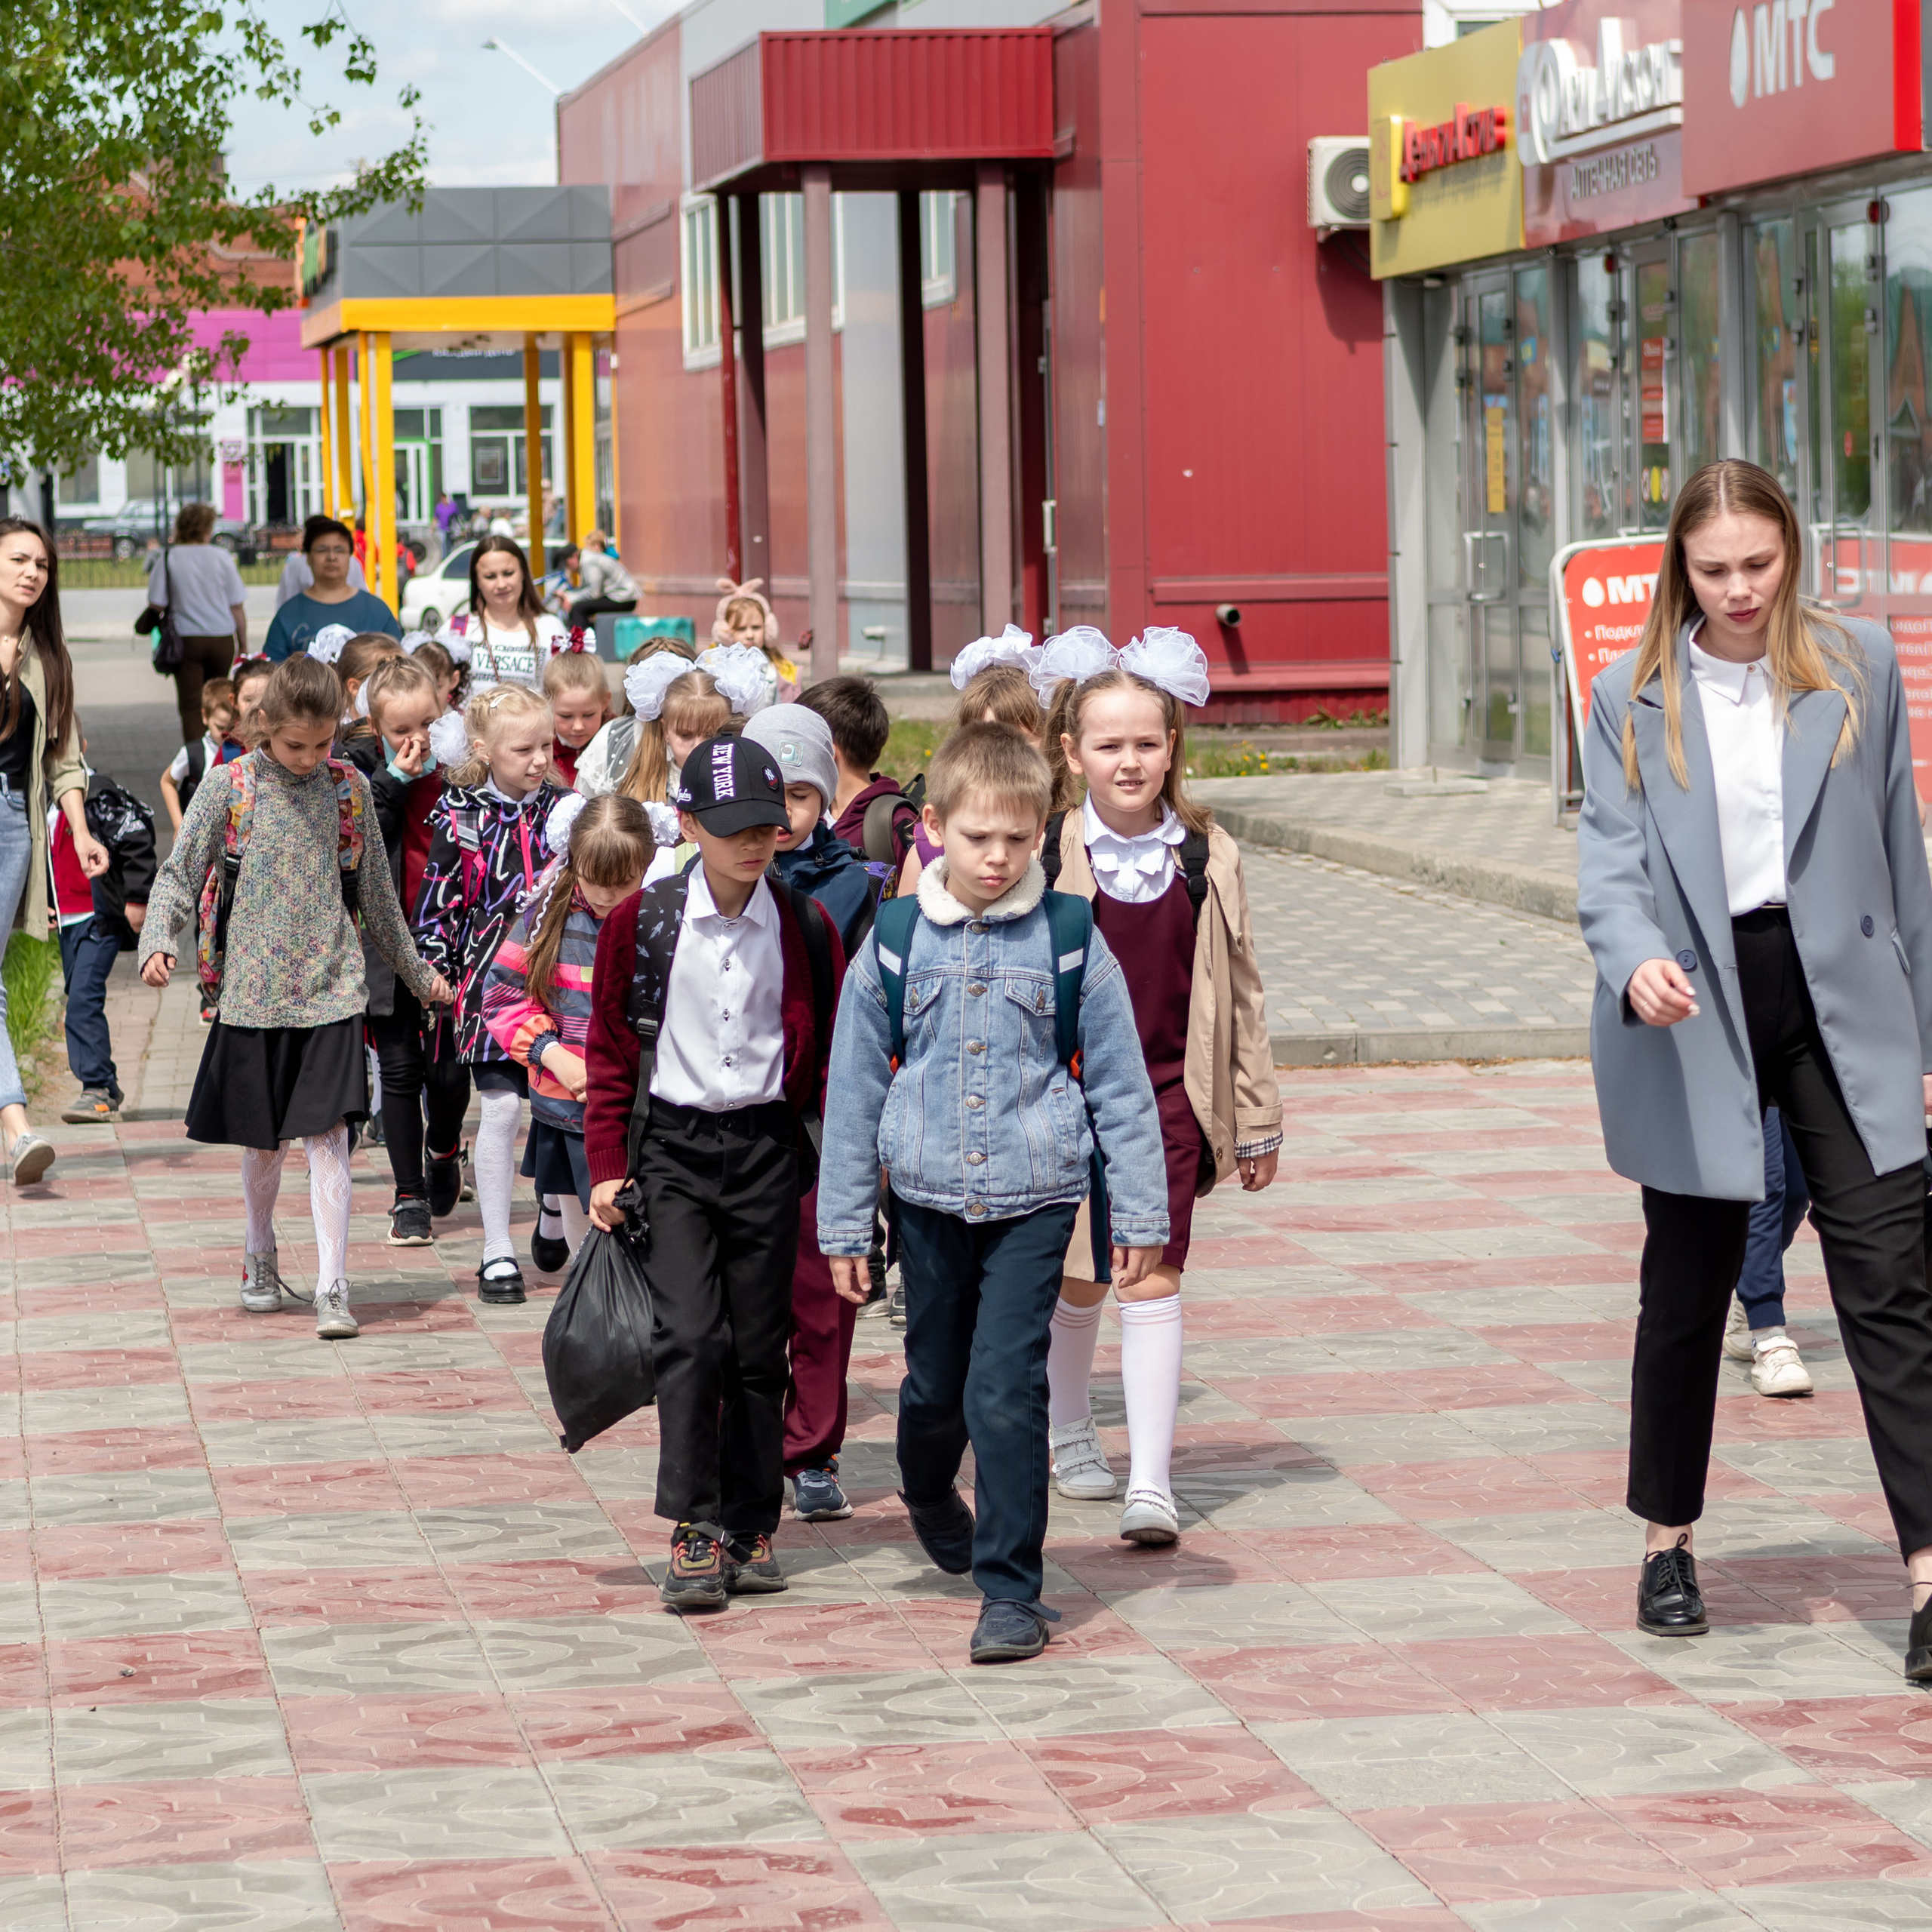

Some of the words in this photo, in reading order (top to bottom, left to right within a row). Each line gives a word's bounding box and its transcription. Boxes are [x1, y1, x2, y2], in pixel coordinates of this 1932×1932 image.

[1753, 0, 1835, 98] МТС
[1570, 151, 1629, 200] АПТЕЧНАЯ
[1629, 143, 1659, 185] СЕТЬ
[1606, 572, 1660, 605] МТ
[1595, 623, 1644, 641] Подкл
[476, 653, 534, 674] VERSACE
[712, 743, 734, 764] NEW
[712, 765, 734, 801] YORK
